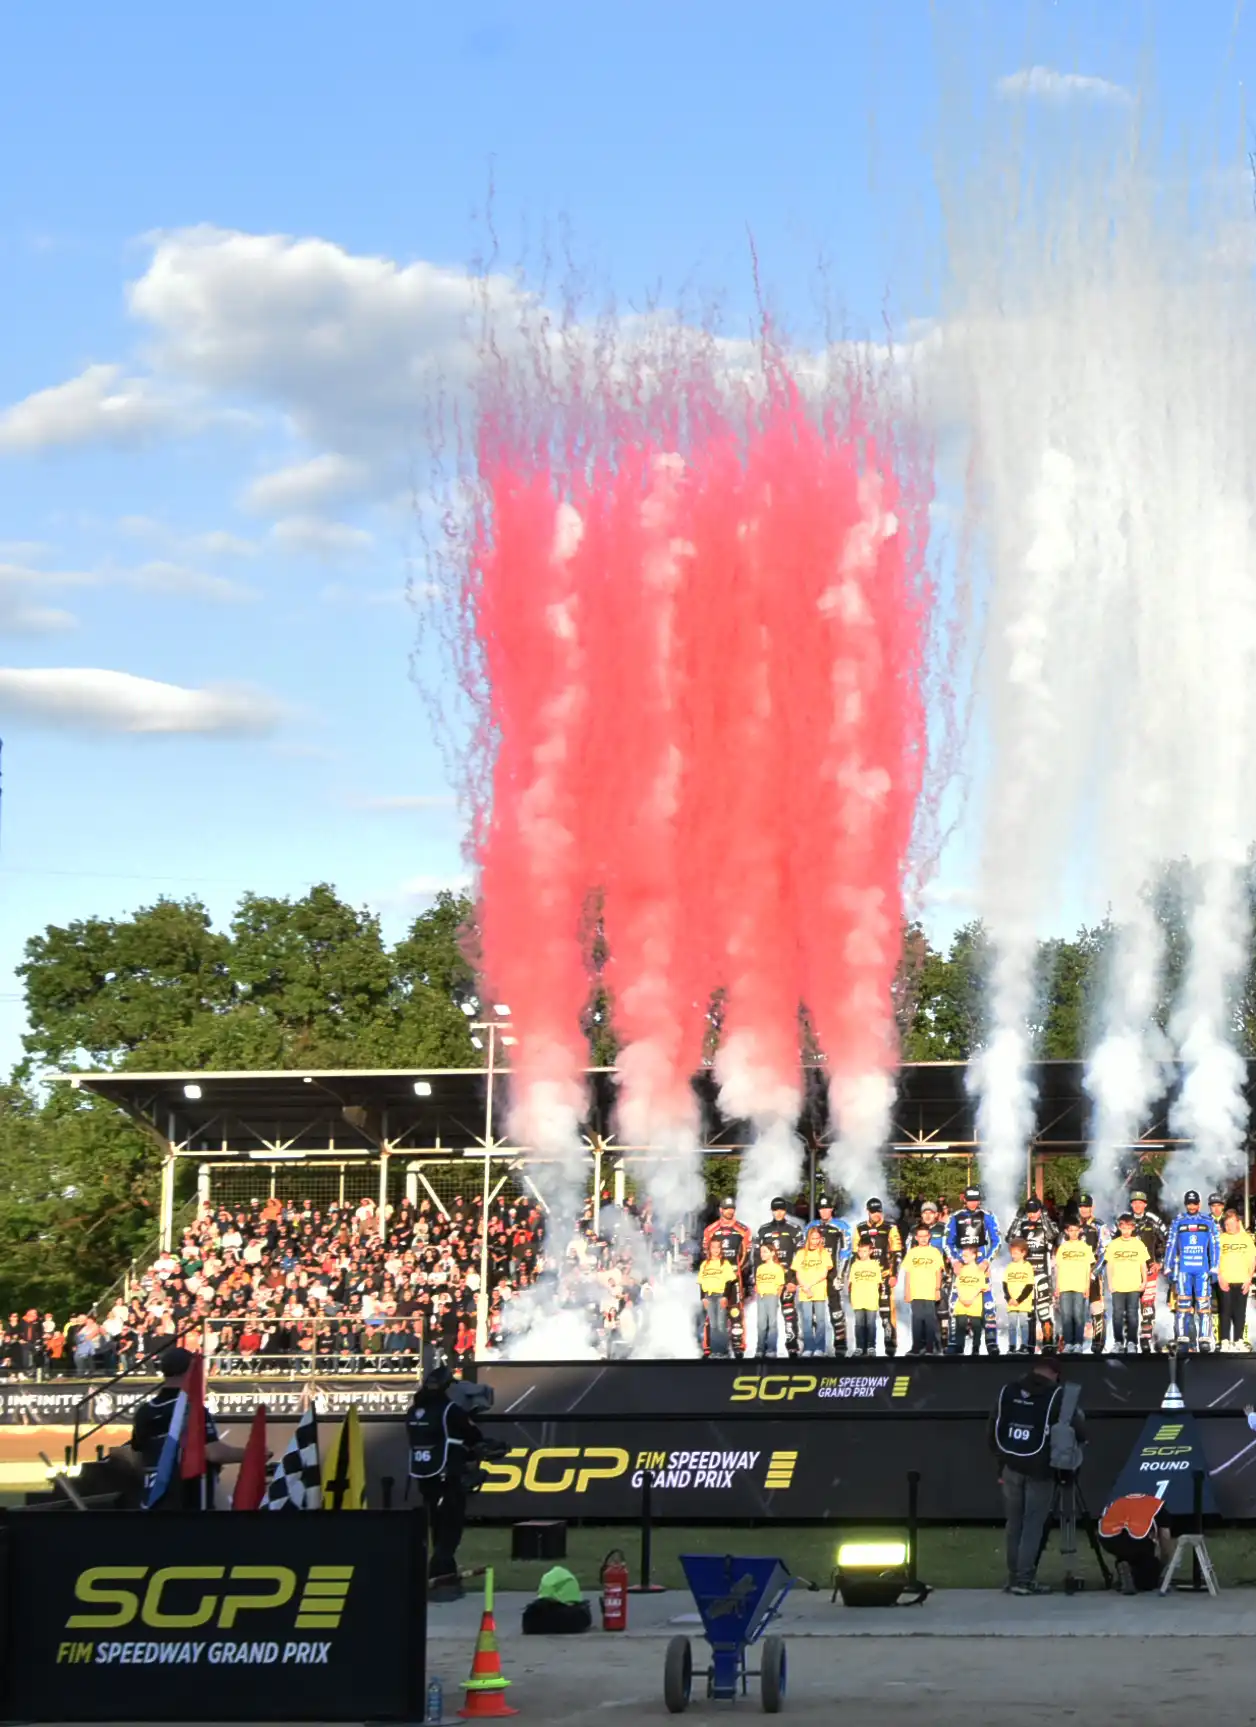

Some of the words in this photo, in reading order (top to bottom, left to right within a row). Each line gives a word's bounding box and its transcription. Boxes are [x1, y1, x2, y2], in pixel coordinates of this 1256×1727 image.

[1113, 1251, 1138, 1259] SGP
[730, 1375, 817, 1400] SGP
[820, 1377, 837, 1387] FIM
[838, 1376, 889, 1387] SPEEDWAY
[818, 1388, 851, 1397] GRAND
[852, 1388, 875, 1397] PRIX
[7, 1394, 84, 1406] INFINITE
[223, 1394, 299, 1405] INFINITE
[333, 1392, 409, 1403] INFINITE
[1140, 1445, 1192, 1457] SGP
[473, 1447, 630, 1492] SGP
[635, 1451, 665, 1469] FIM
[667, 1451, 761, 1470] SPEEDWAY
[1139, 1461, 1190, 1471] ROUND
[692, 1470, 736, 1488] PRIX
[1154, 1480, 1170, 1500] 1
[65, 1566, 297, 1628] SGP
[56, 1642, 93, 1664] FIM
[94, 1642, 206, 1664] SPEEDWAY
[207, 1642, 279, 1664] GRAND
[281, 1642, 332, 1664] PRIX
